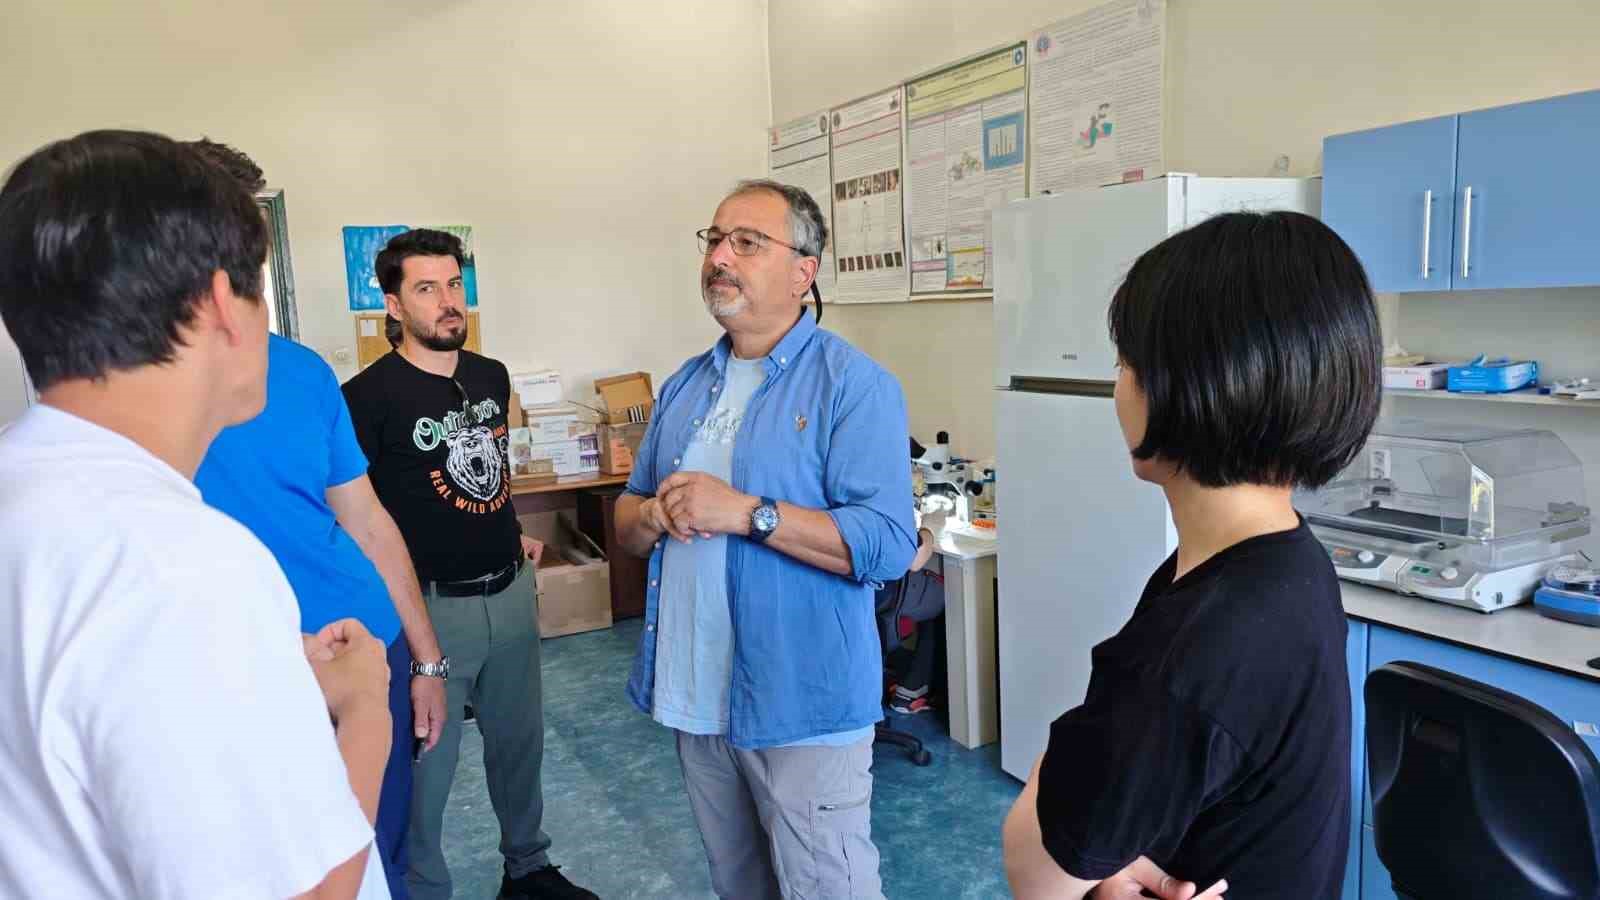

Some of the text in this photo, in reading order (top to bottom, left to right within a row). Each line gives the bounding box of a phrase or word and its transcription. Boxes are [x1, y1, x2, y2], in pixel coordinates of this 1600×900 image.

[413, 398, 500, 451] Outdor
[430, 470, 452, 499] REAL
[455, 496, 485, 514] WILD
